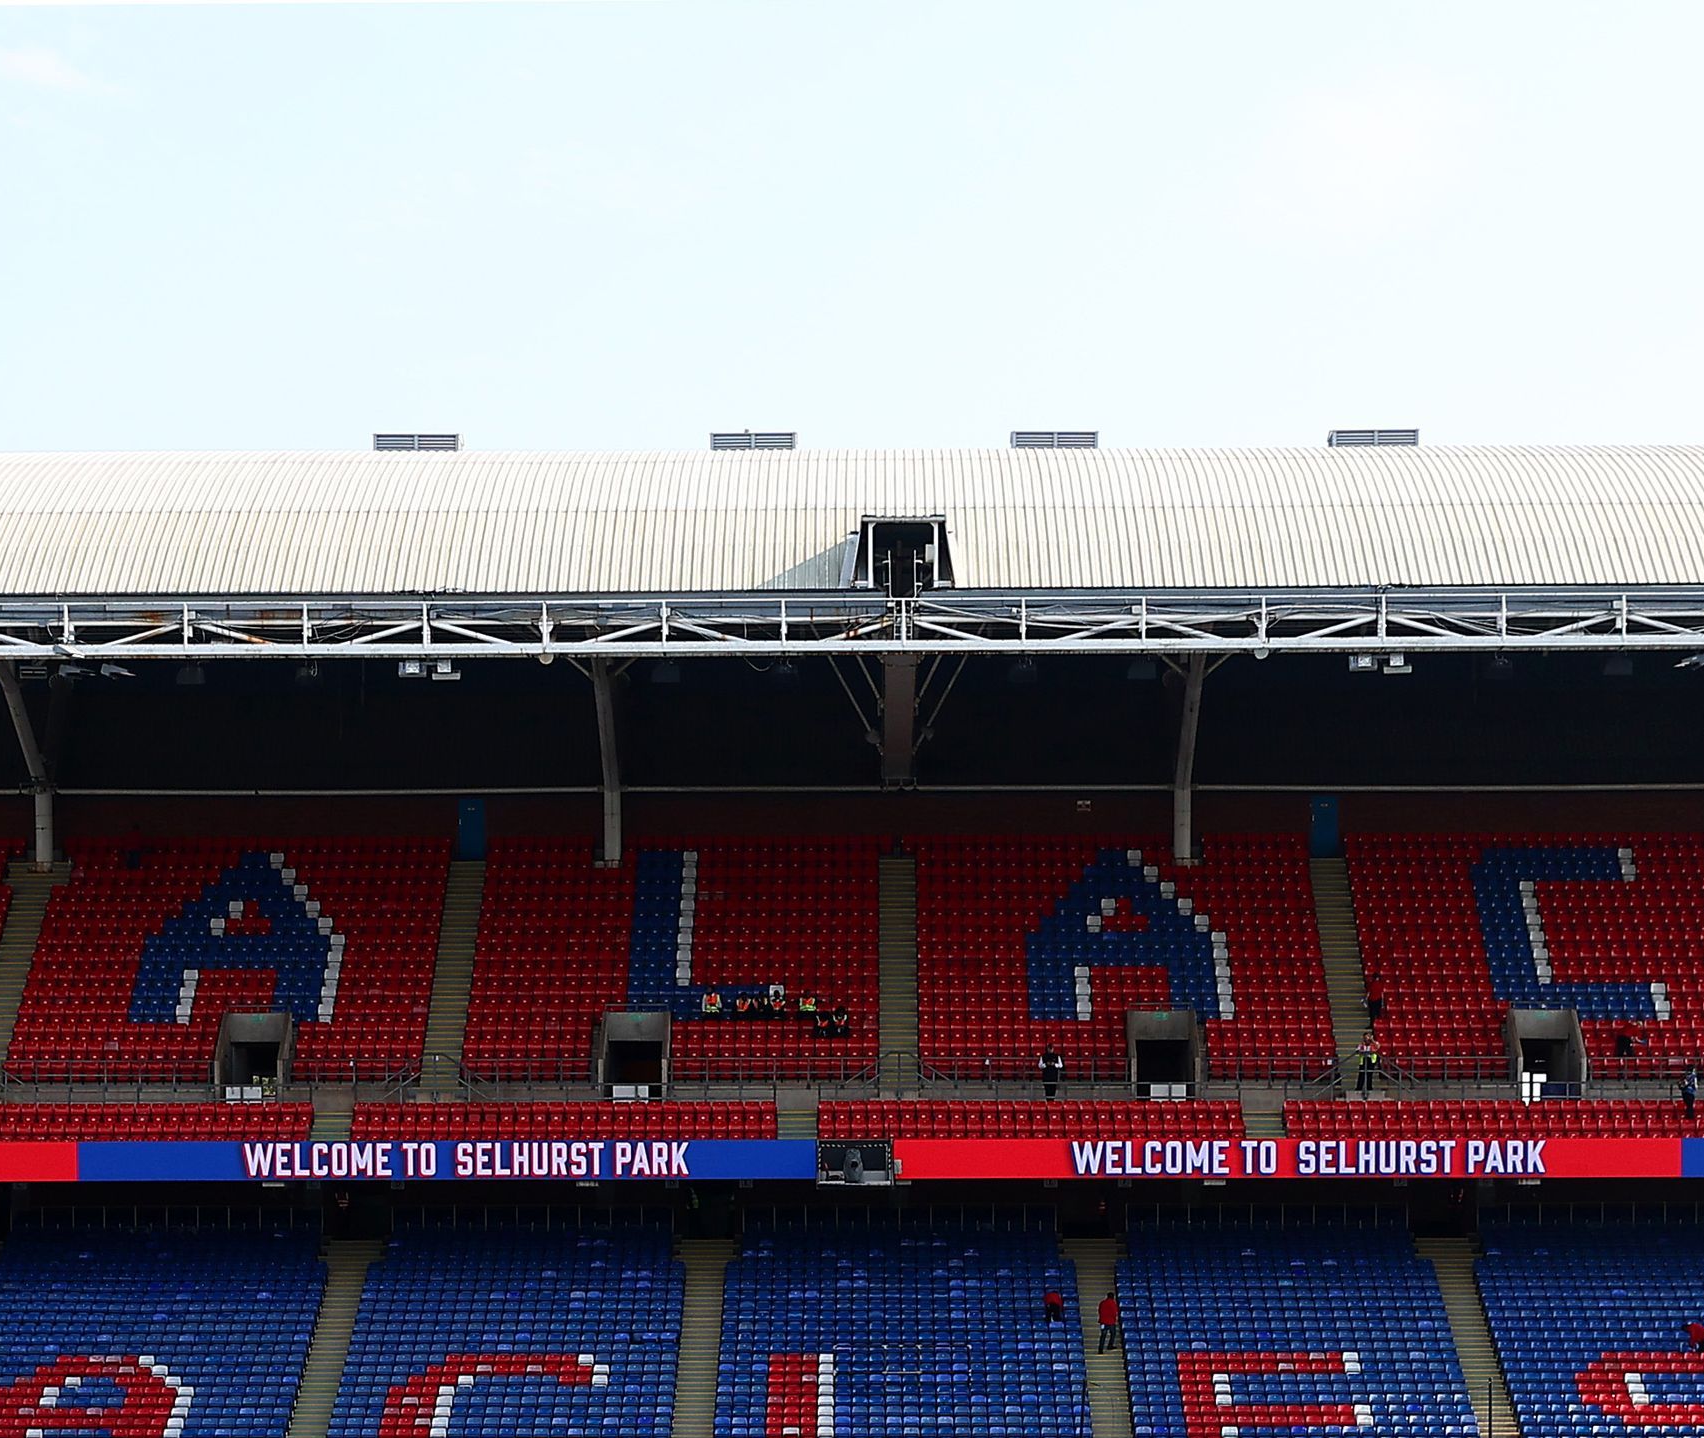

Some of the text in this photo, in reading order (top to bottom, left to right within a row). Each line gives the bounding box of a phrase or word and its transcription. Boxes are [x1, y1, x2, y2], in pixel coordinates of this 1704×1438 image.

[244, 1141, 690, 1177] WELCOME TO SELHURST PARK
[1072, 1140, 1546, 1175] WELCOME TO SELHURST PARK
